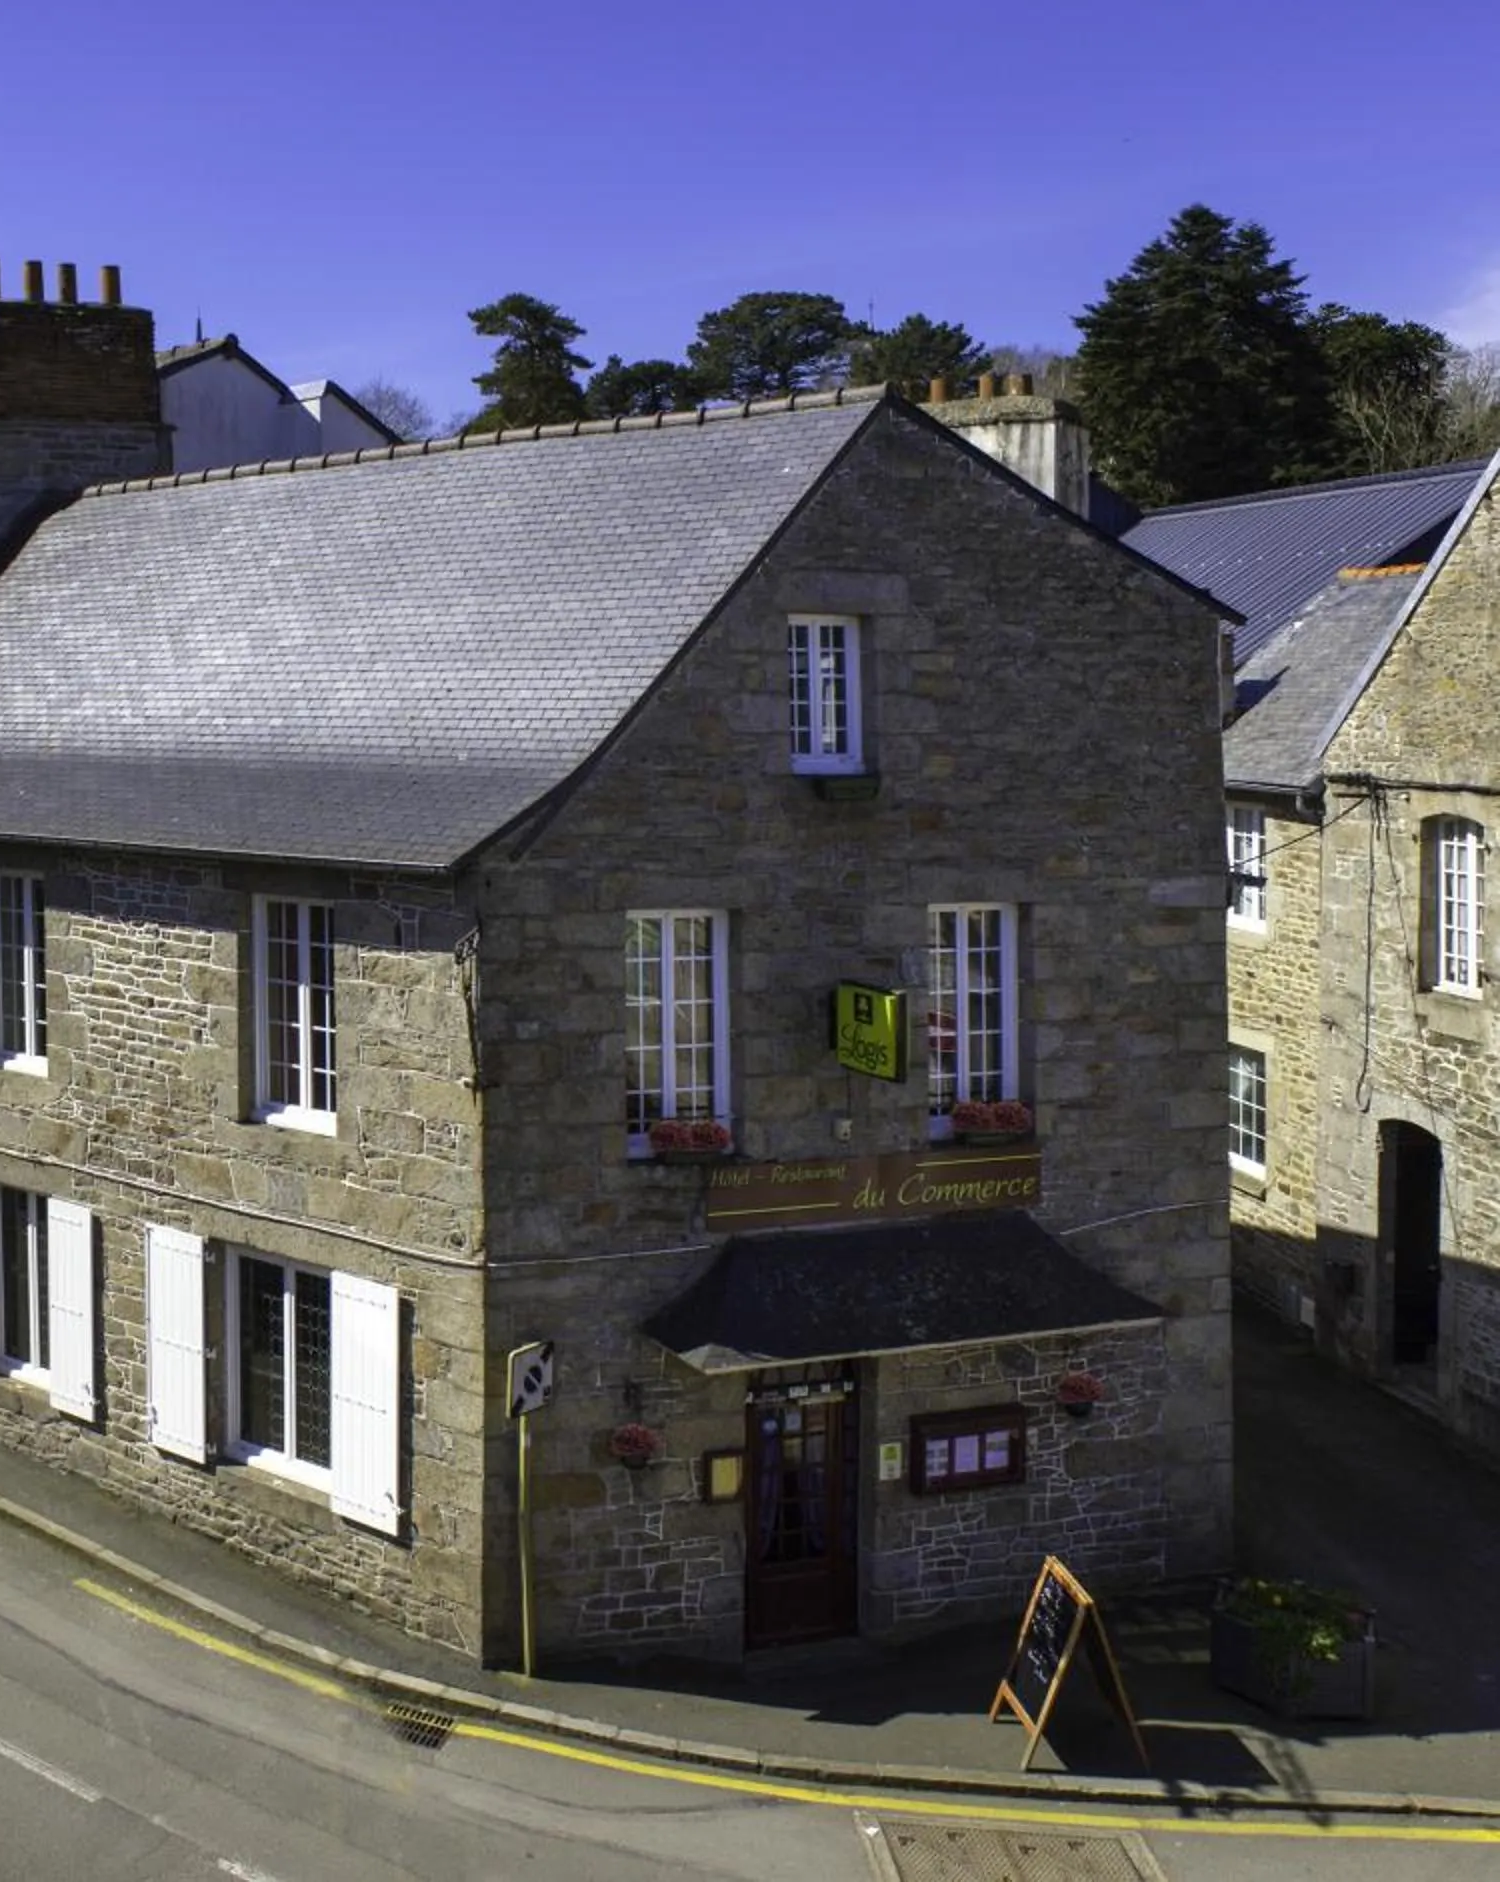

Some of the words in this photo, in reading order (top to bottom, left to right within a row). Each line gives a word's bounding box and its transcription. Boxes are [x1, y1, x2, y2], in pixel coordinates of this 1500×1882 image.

[841, 1023, 887, 1071] Logis
[853, 1177, 886, 1210] du
[897, 1172, 1037, 1206] Commerce
